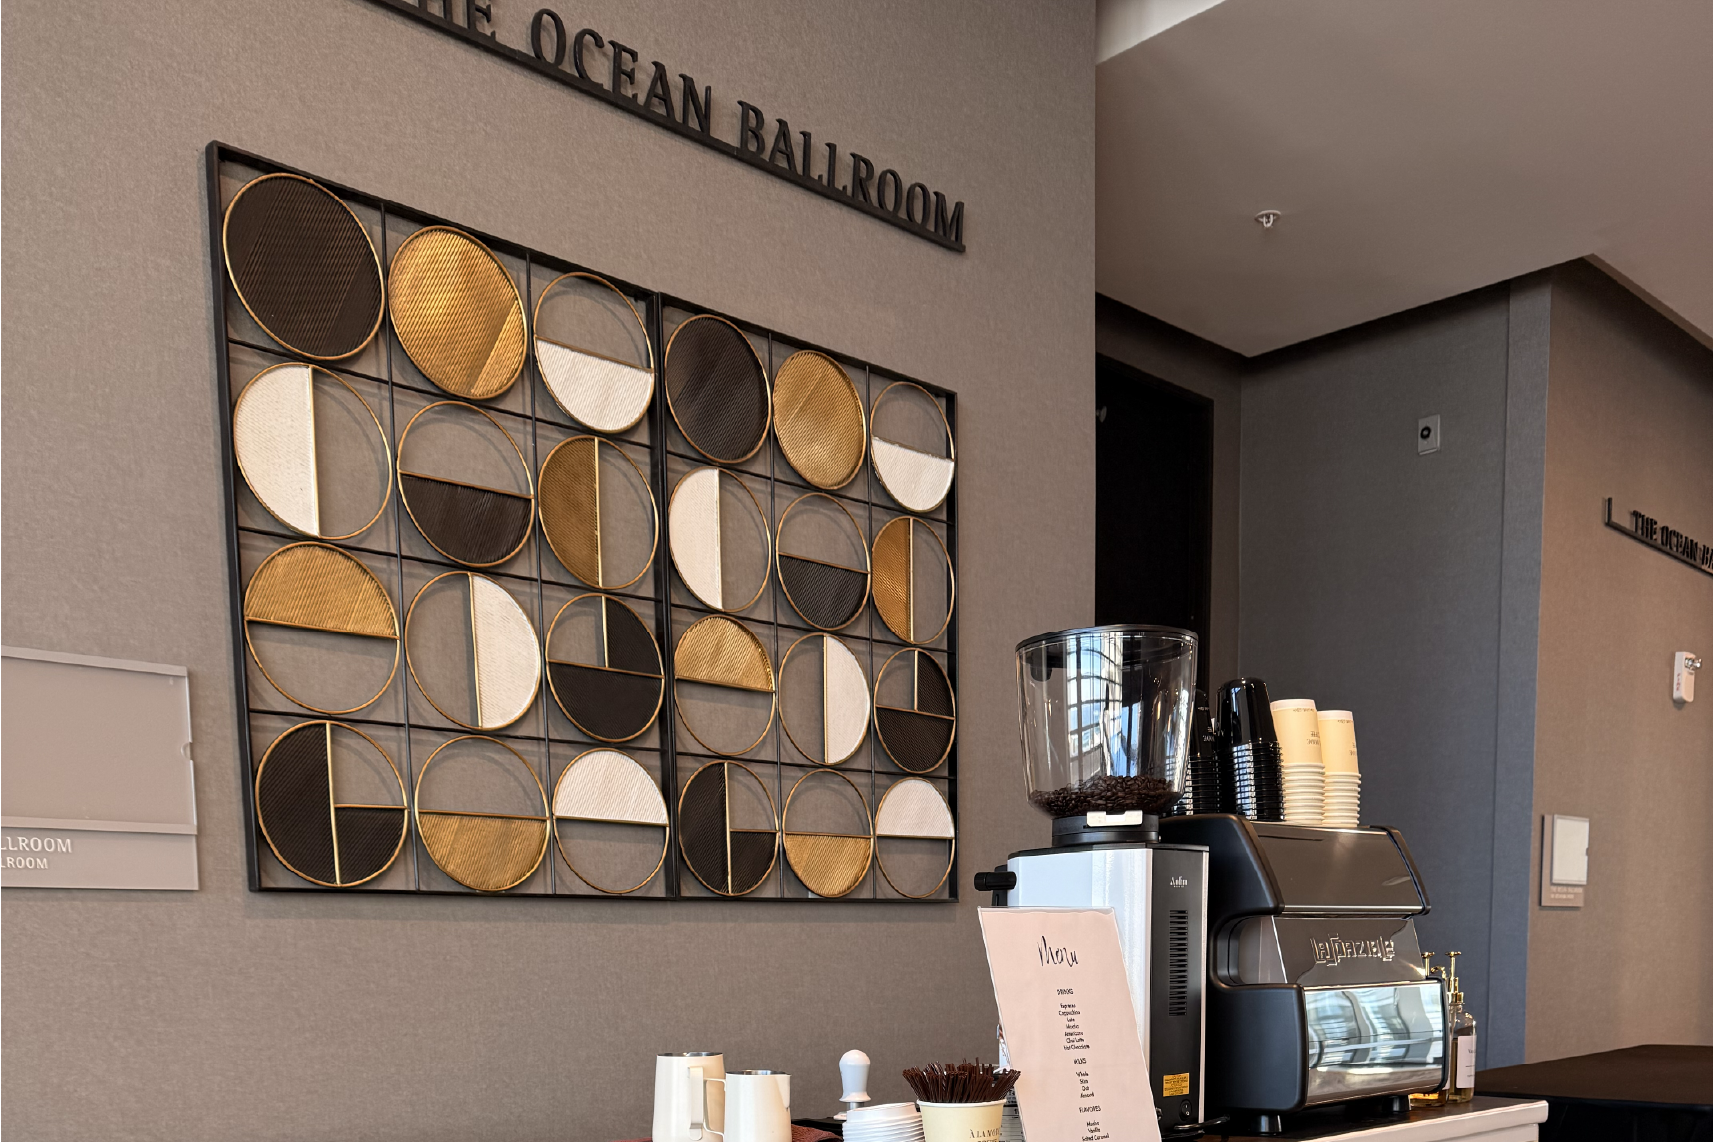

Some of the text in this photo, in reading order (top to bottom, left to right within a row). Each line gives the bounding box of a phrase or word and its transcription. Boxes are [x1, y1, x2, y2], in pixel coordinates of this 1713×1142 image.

[530, 8, 711, 136] OCEAN
[737, 99, 965, 248] BALLROOM
[1632, 510, 1658, 541] THE
[1660, 525, 1699, 562] OCEAN
[1036, 935, 1078, 967] Menu
